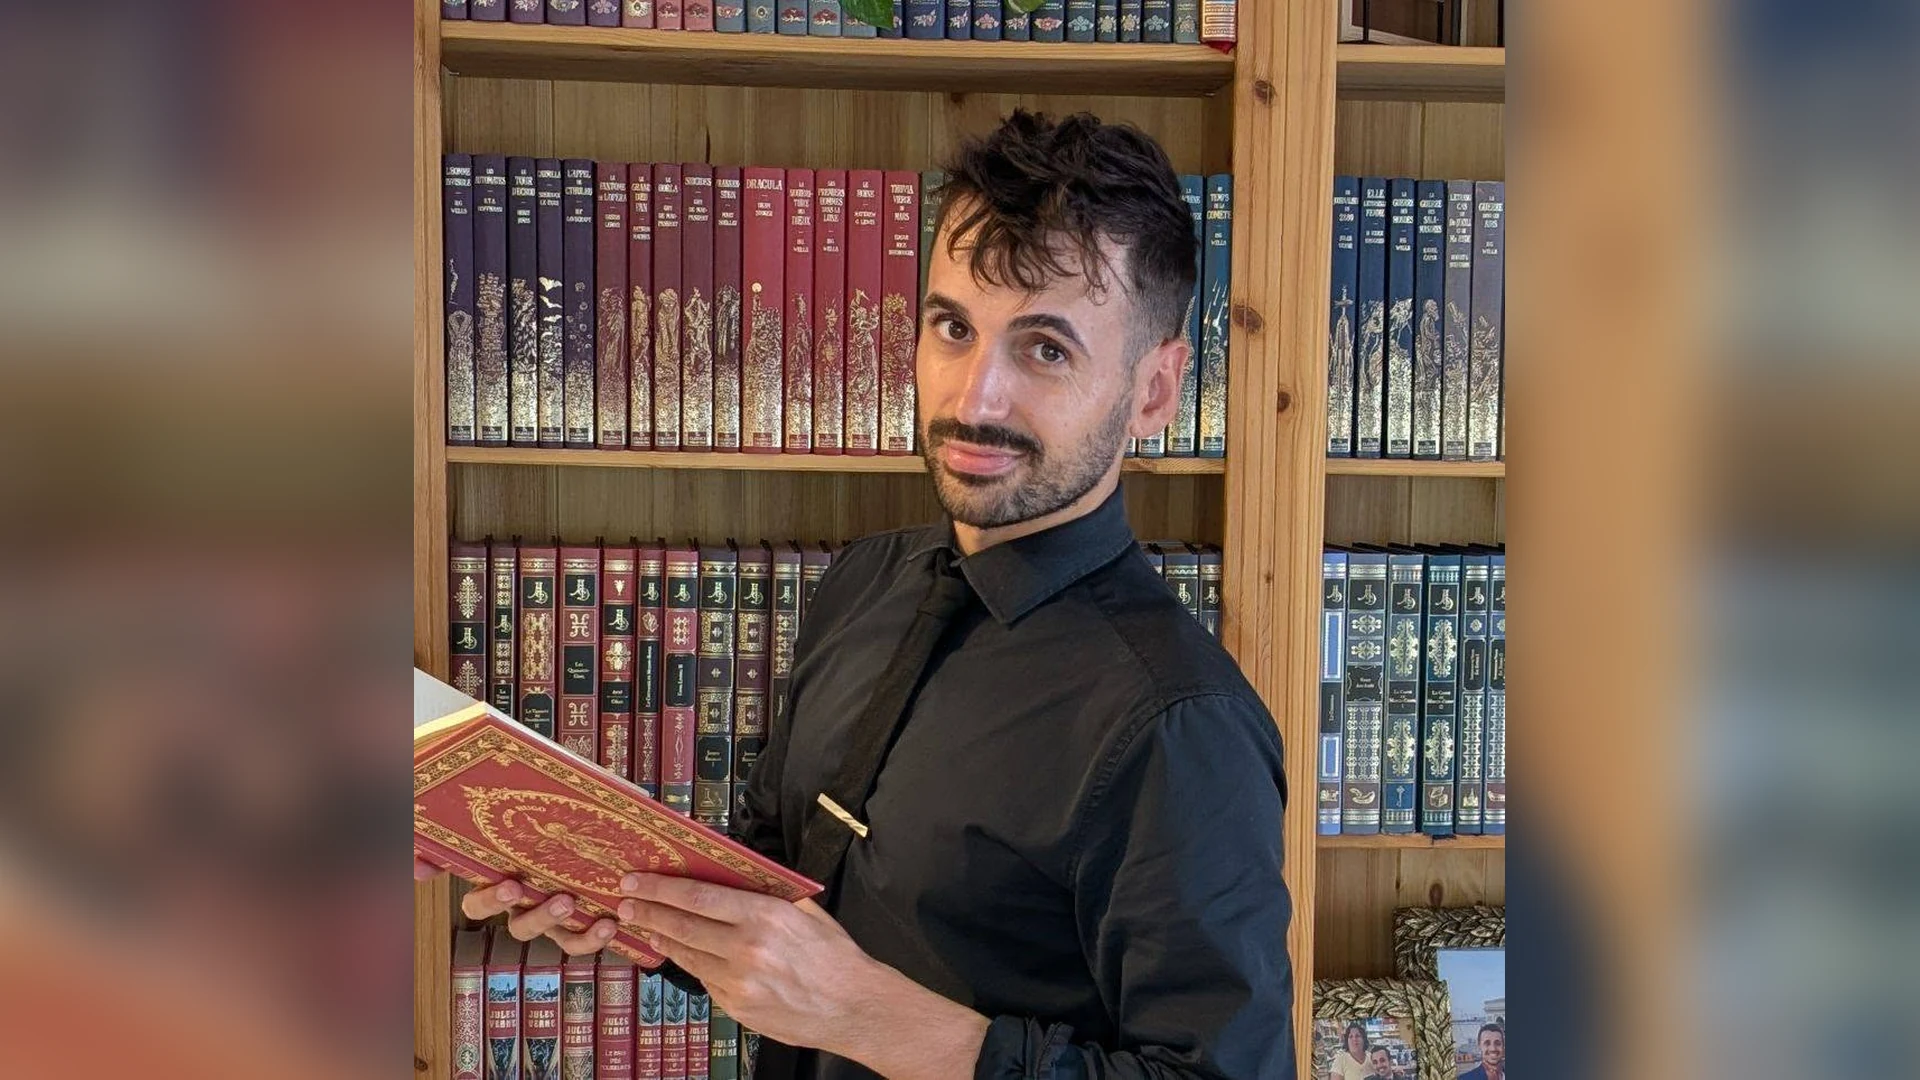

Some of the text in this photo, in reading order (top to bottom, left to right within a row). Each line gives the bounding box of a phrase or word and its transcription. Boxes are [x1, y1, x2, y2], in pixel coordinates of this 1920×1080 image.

[746, 178, 783, 191] DRACULA
[490, 1009, 516, 1019] JULES
[528, 1009, 555, 1019] JULES
[490, 1019, 517, 1028] VERNE
[528, 1019, 556, 1028] VERNE
[603, 1017, 629, 1026] JULES
[565, 1025, 593, 1034] JULES
[602, 1026, 630, 1035] VERNE
[640, 1029, 661, 1038] JULES
[665, 1028, 685, 1037] JULES
[689, 1026, 708, 1035] JULES
[565, 1034, 593, 1043] VERNE
[640, 1037, 661, 1045] VERNE
[664, 1036, 686, 1044] VERNE
[688, 1034, 709, 1043] VERNE
[712, 1039, 737, 1048] JULES
[711, 1047, 737, 1057] VERNE
